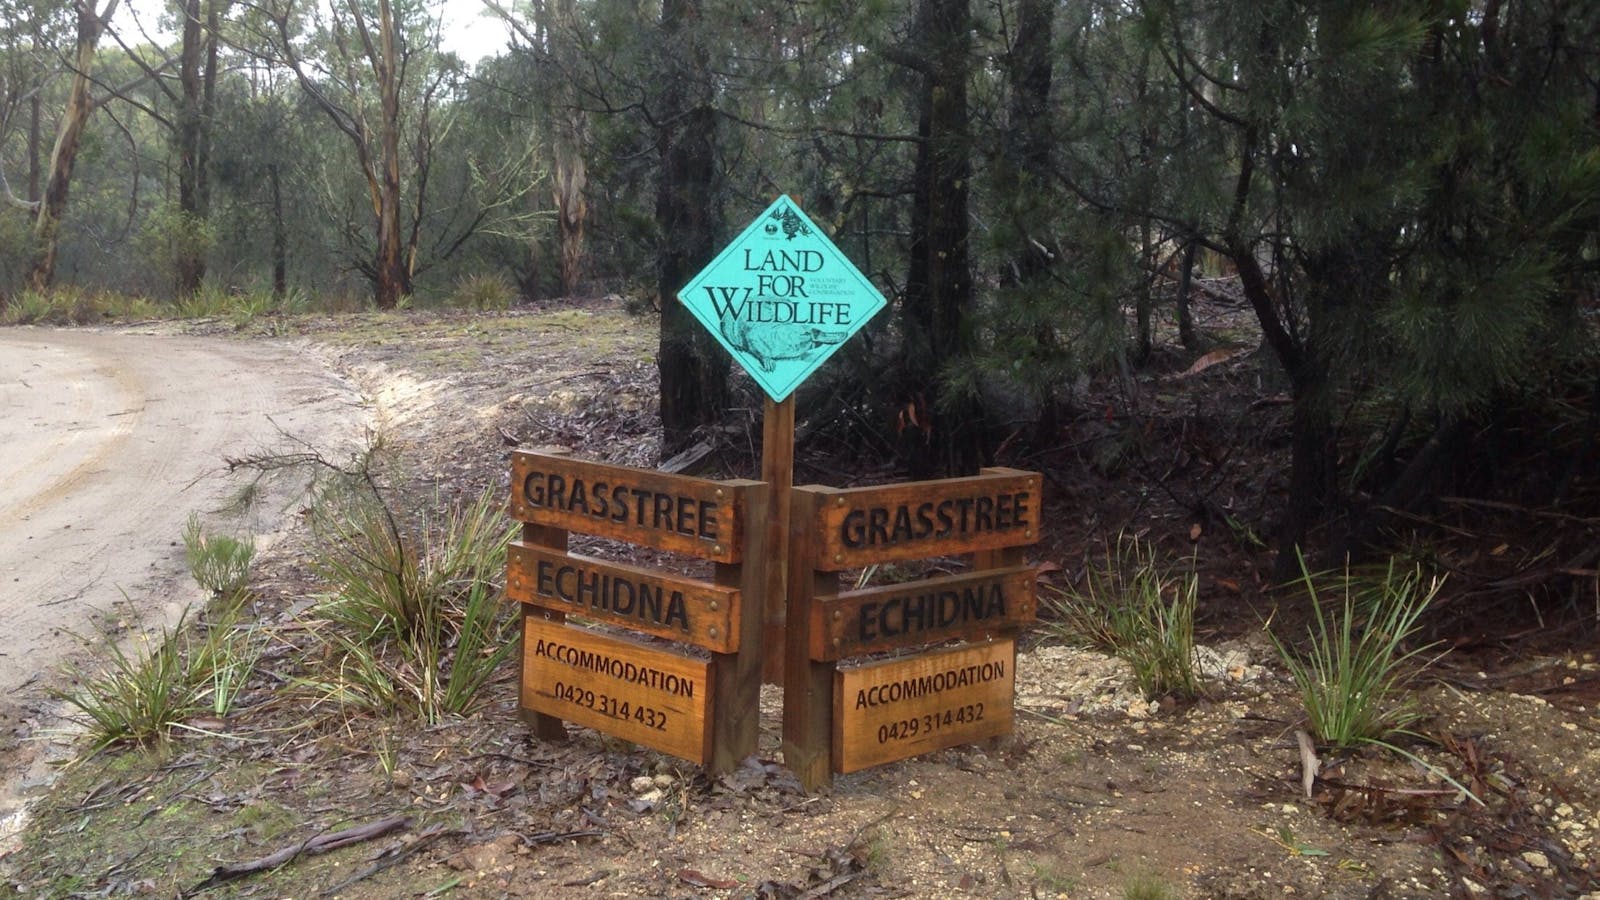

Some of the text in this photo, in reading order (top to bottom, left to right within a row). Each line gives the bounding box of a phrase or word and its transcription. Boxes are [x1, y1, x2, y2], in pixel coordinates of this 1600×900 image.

[744, 249, 824, 272] LAND
[703, 286, 850, 325] WILDLIFE
[757, 275, 809, 298] FOR
[523, 471, 718, 540] GRASSTREE
[841, 492, 1030, 549] GRASSTREE
[536, 560, 689, 632] ECHIDNA
[859, 582, 1006, 642] ECHIDNA
[535, 639, 694, 698] ACCOMMODATION
[855, 660, 1005, 710] ACCOMMODATION
[555, 681, 667, 732] 0429 314 432
[878, 702, 985, 744] 0429 314 432
